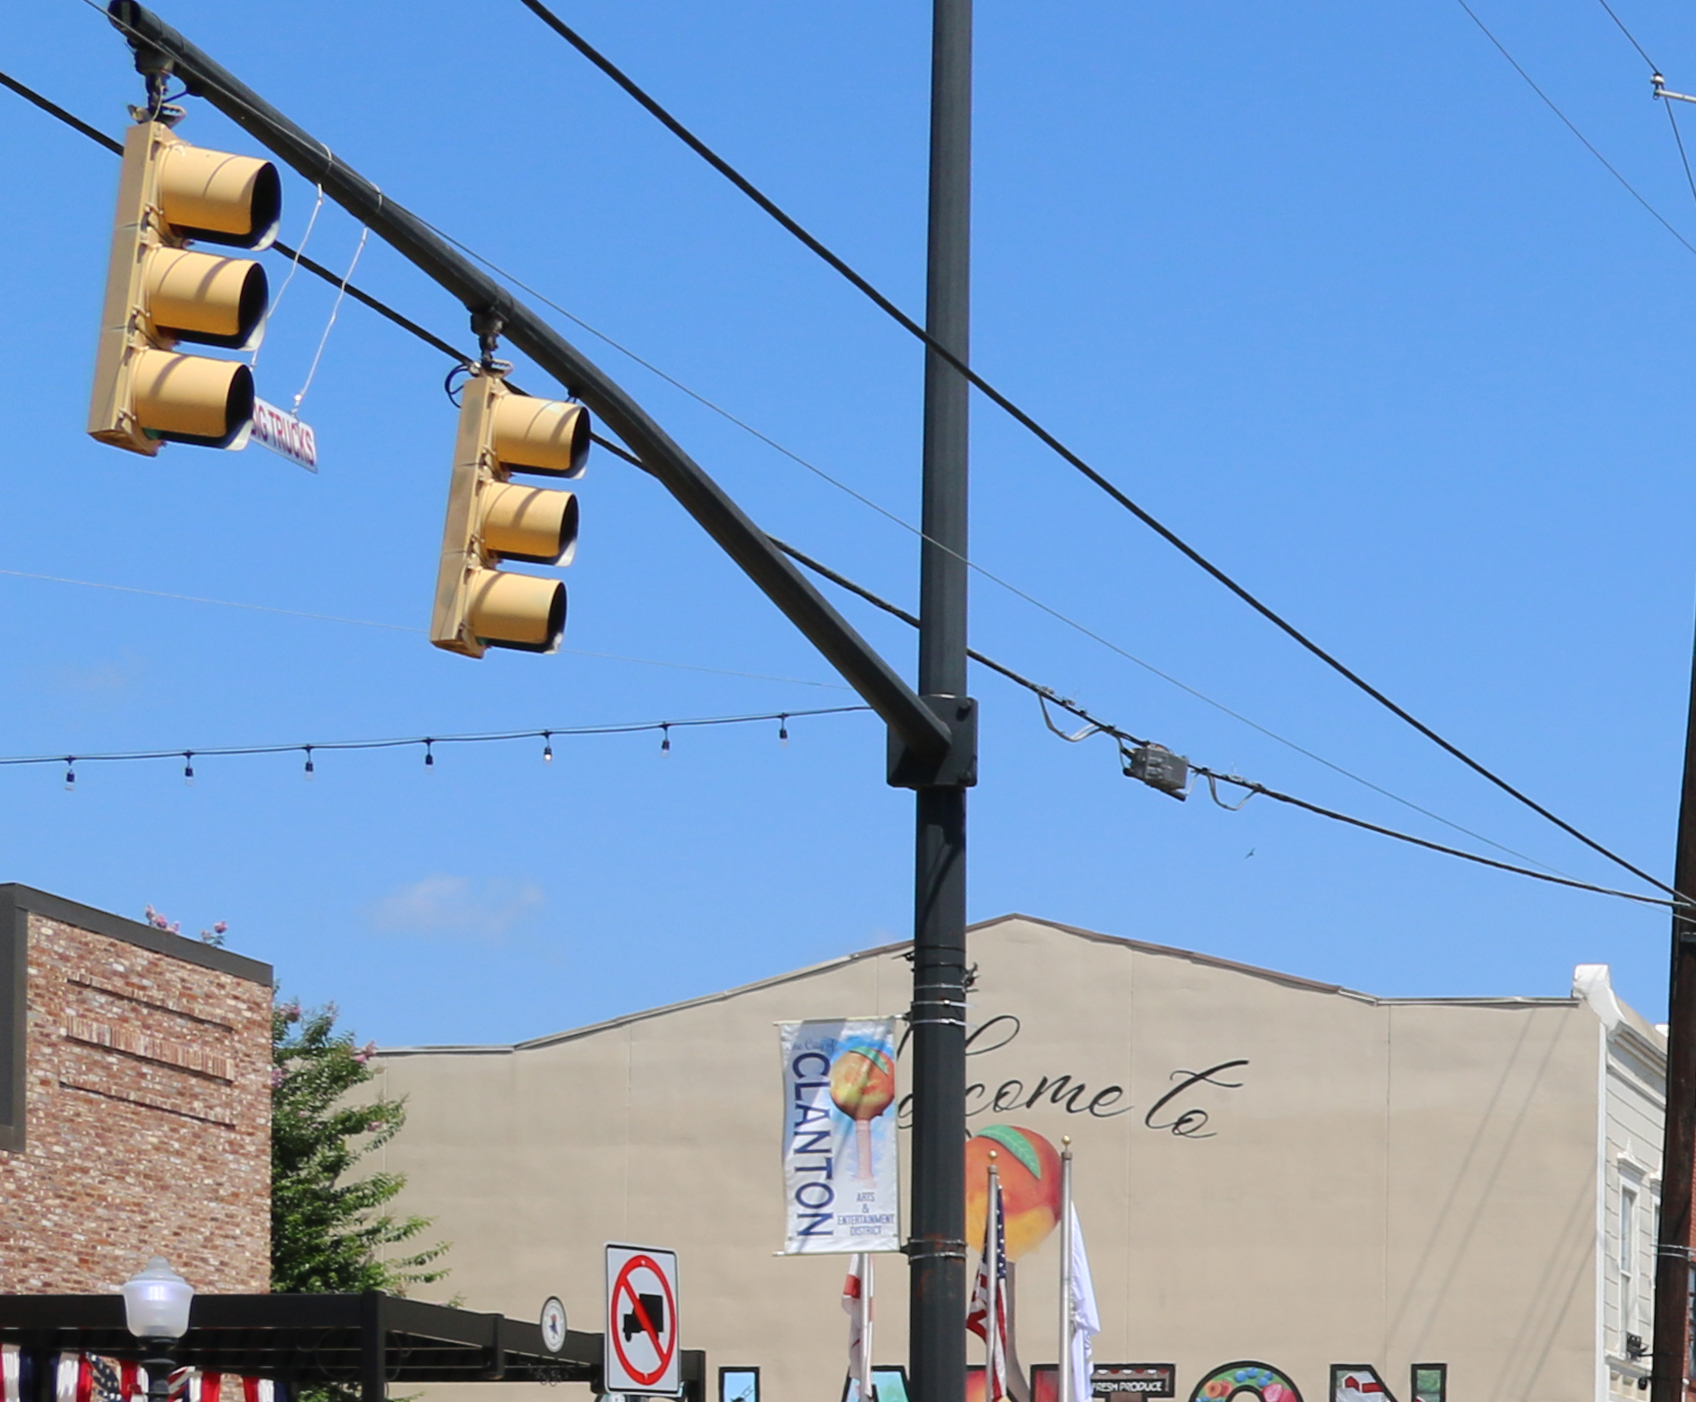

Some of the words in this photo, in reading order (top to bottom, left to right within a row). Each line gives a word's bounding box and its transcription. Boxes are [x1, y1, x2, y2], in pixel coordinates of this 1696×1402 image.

[268, 409, 315, 466] TRUCKS
[792, 1052, 834, 1236] CLANTON
[856, 1191, 875, 1202] ARTS
[862, 1203, 870, 1213] &
[837, 1214, 895, 1225] ENTERTAINMENT
[850, 1225, 882, 1236] DISTRICT
[1092, 1382, 1119, 1392] FRESH
[1119, 1381, 1163, 1392] PRODUCE
